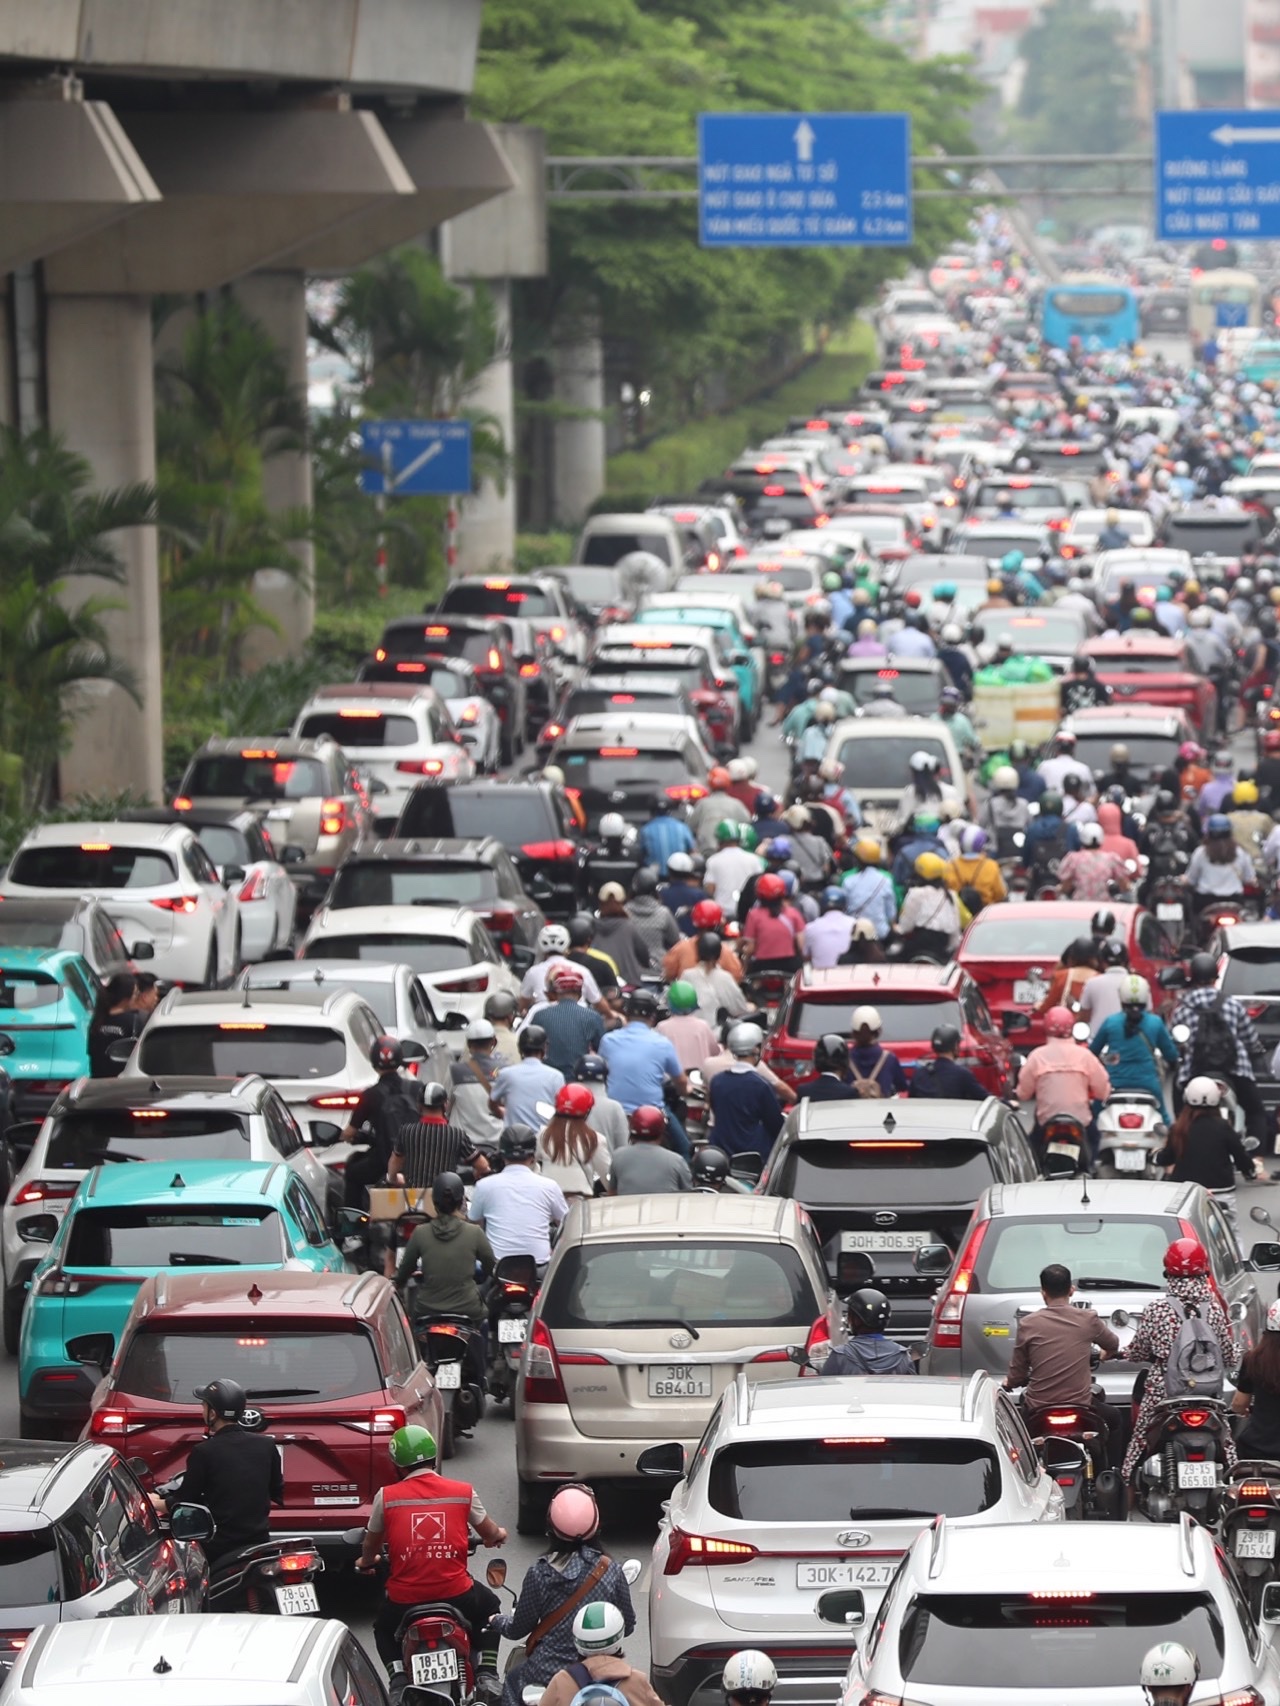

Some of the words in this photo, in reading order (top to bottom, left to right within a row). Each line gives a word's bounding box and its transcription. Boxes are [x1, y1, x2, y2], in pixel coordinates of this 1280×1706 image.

[849, 1236, 923, 1249] 30H-306.95
[667, 1366, 693, 1380] 30K
[655, 1382, 704, 1395] 684.01
[1184, 1463, 1210, 1475] 29-X5
[1181, 1476, 1214, 1487] 665.80
[1242, 1532, 1269, 1543] 29-B1
[1238, 1544, 1271, 1556] 715.44
[283, 1598, 317, 1614] 171.51
[419, 1652, 450, 1669] 18-L1
[417, 1665, 455, 1683] 128.31
